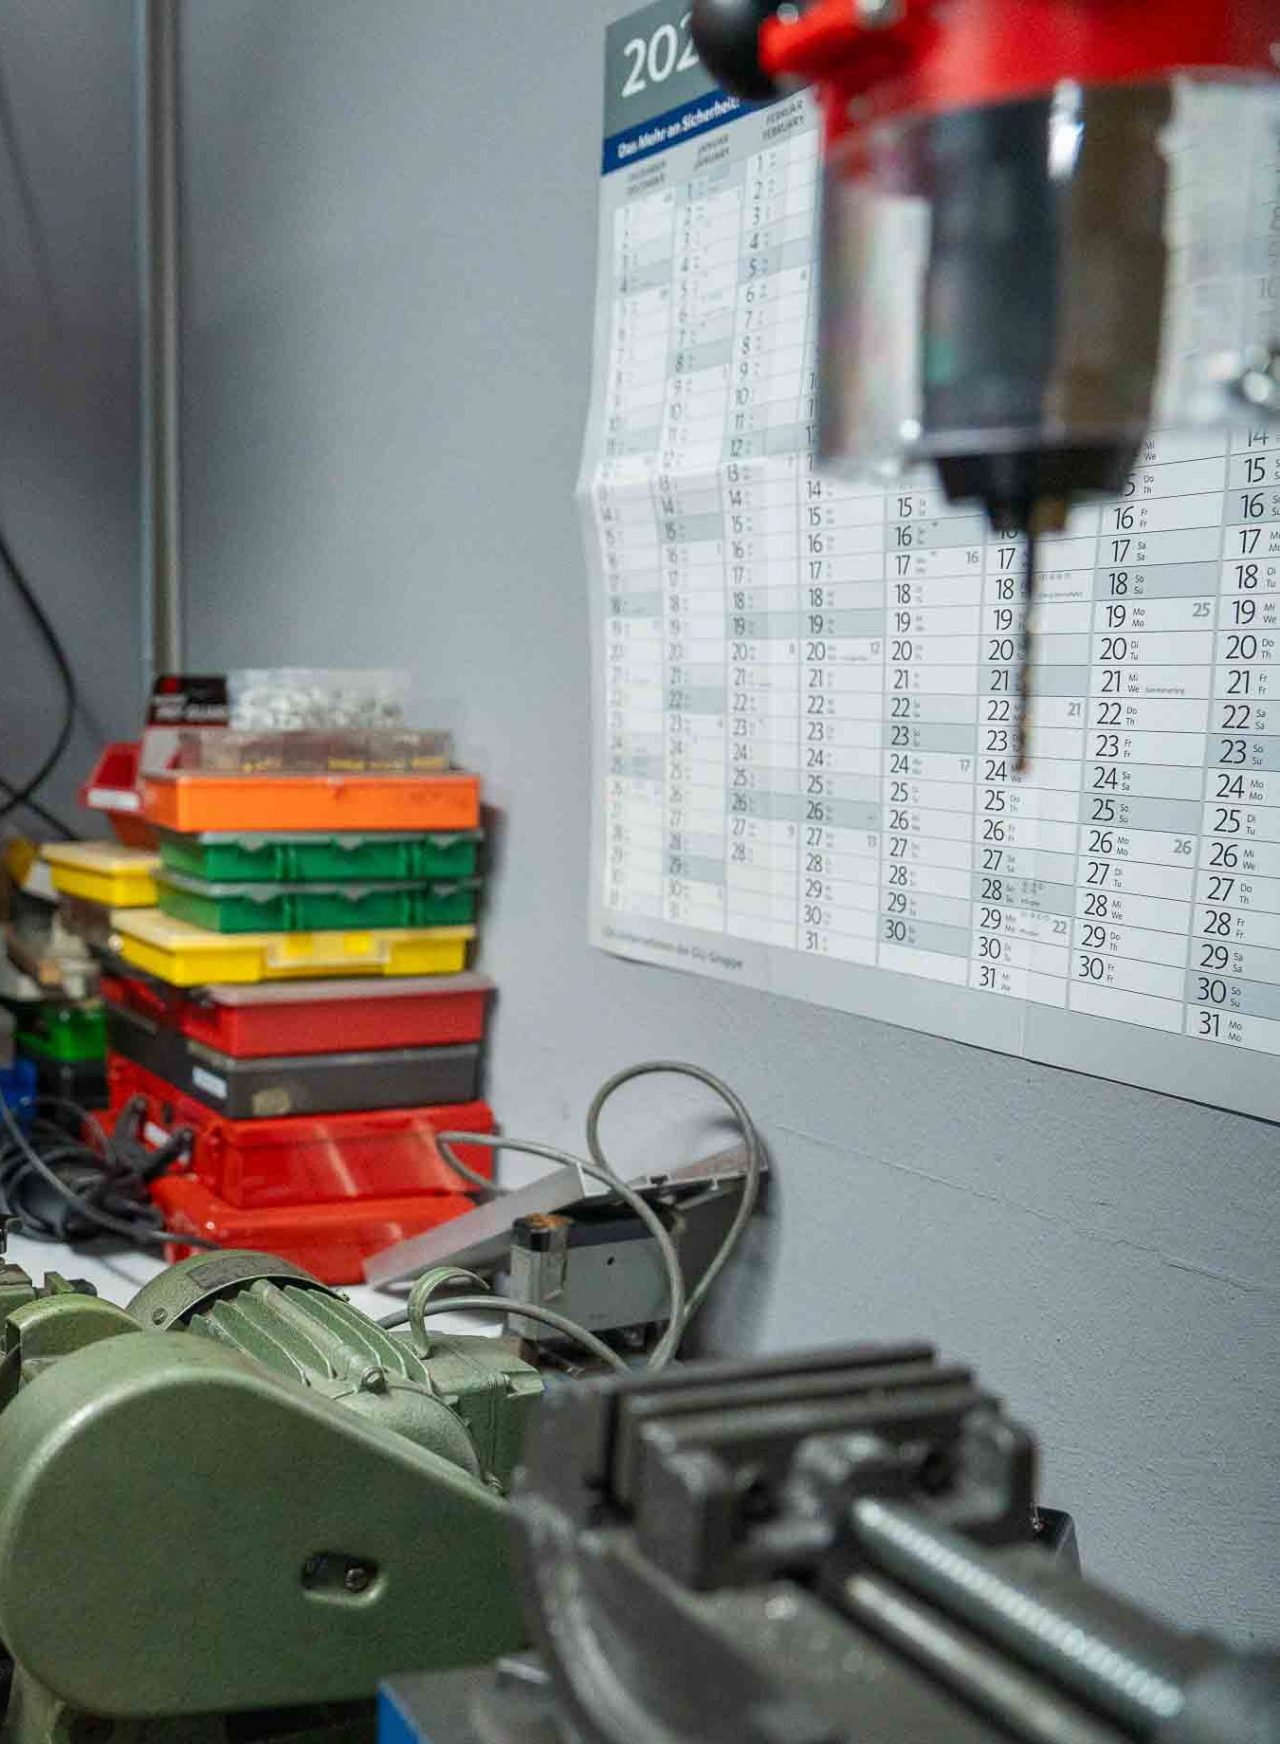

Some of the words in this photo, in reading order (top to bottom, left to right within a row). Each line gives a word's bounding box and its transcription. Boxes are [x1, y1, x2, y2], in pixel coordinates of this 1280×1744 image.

[621, 13, 700, 98] 202
[617, 141, 638, 159] Das
[638, 126, 666, 150] Mehr
[666, 123, 681, 139] an
[1244, 457, 1266, 483] 15
[808, 506, 821, 526] 15
[897, 497, 912, 518] 15
[1240, 493, 1264, 518] 16
[1114, 506, 1134, 530] 16
[808, 533, 822, 553] 16
[895, 525, 912, 546] 16
[1238, 529, 1261, 554] 17
[966, 551, 979, 564] 16
[998, 547, 1016, 569] 17
[1111, 539, 1131, 562] 17
[809, 561, 822, 579] 17
[896, 555, 911, 575] 17
[1267, 568, 1276, 576] Di
[1109, 572, 1128, 595] 18
[1235, 564, 1258, 589] 18
[1266, 580, 1276, 588] Tu
[809, 588, 822, 608] 18
[895, 583, 911, 604] 18
[995, 578, 1014, 600] 18
[1106, 605, 1126, 628] 19
[1192, 603, 1210, 617] 25
[1232, 599, 1256, 624] 19
[1264, 603, 1275, 611] Mi
[808, 614, 823, 634] 19
[895, 612, 911, 632] 19
[993, 609, 1013, 630] 19
[1263, 615, 1276, 624] We
[806, 641, 826, 661] 20
[892, 640, 912, 661] 20
[989, 639, 1014, 661] 20
[1100, 637, 1127, 660] 20
[1225, 635, 1257, 660] 20
[1262, 639, 1274, 647] Do
[1261, 651, 1271, 659] Th
[809, 668, 822, 688] 21
[894, 669, 908, 689] 21
[990, 669, 1008, 691] 21
[1101, 670, 1121, 693] 21
[1227, 670, 1250, 694] 21
[1259, 674, 1268, 683] Fr
[1258, 686, 1267, 695] Fr
[807, 695, 824, 715] 22
[891, 698, 910, 718] 22
[987, 700, 1010, 721] 22
[1067, 703, 1081, 716] 21
[1097, 702, 1122, 725] 22
[1256, 709, 1266, 718] Sa
[1221, 705, 1251, 729] 22
[1255, 721, 1265, 730] Sa
[891, 726, 909, 746] 23
[987, 730, 1007, 751] 23
[1095, 734, 1119, 757] 23
[1220, 739, 1247, 765] 23
[1253, 744, 1264, 753] So
[890, 753, 909, 773] 24
[985, 760, 1007, 782] 24
[1252, 757, 1262, 766] Su
[1093, 766, 1118, 790] 24
[1216, 774, 1245, 799] 24
[1250, 780, 1264, 789] Mo
[890, 781, 908, 802] 25
[985, 789, 1005, 811] 25
[1249, 792, 1263, 801] Mo
[890, 809, 908, 830] 26
[1092, 798, 1115, 822] 25
[1214, 808, 1241, 833] 25
[1247, 814, 1256, 823] Di
[806, 827, 822, 847] 27
[983, 819, 1004, 841] 26
[1246, 826, 1255, 835] Tu
[890, 837, 907, 857] 27
[1089, 830, 1113, 854] 26
[1173, 839, 1192, 855] 26
[983, 849, 1003, 870] 27
[1209, 842, 1238, 868] 26
[1243, 849, 1255, 858] Mi
[889, 865, 907, 886] 28
[1087, 862, 1110, 885] 27
[1243, 862, 1256, 871] We
[982, 878, 1002, 900] 28
[1208, 876, 1235, 902] 27
[1240, 884, 1252, 893] Do
[887, 892, 906, 913] 29
[1084, 893, 1108, 917] 28
[1239, 896, 1249, 904] Th
[804, 904, 822, 925] 30
[980, 907, 1001, 930] 29
[1203, 910, 1231, 936] 28
[1237, 918, 1245, 927] Fr
[886, 919, 906, 941] 30
[1053, 920, 1067, 934] 22
[1082, 924, 1106, 948] 29
[1236, 930, 1244, 939] Fr
[806, 931, 818, 950] 31
[979, 936, 1001, 959] 30
[1200, 944, 1229, 969] 29
[1234, 953, 1243, 962] Sa
[979, 966, 995, 988] 31
[1079, 956, 1104, 980] 30
[1233, 964, 1242, 974] Sa
[1197, 977, 1227, 1003] 30
[1231, 987, 1241, 996] So
[1230, 999, 1240, 1008] Su
[1199, 1012, 1220, 1037] 31
[1229, 1021, 1242, 1031] Mo
[1228, 1032, 1242, 1042] Mo
